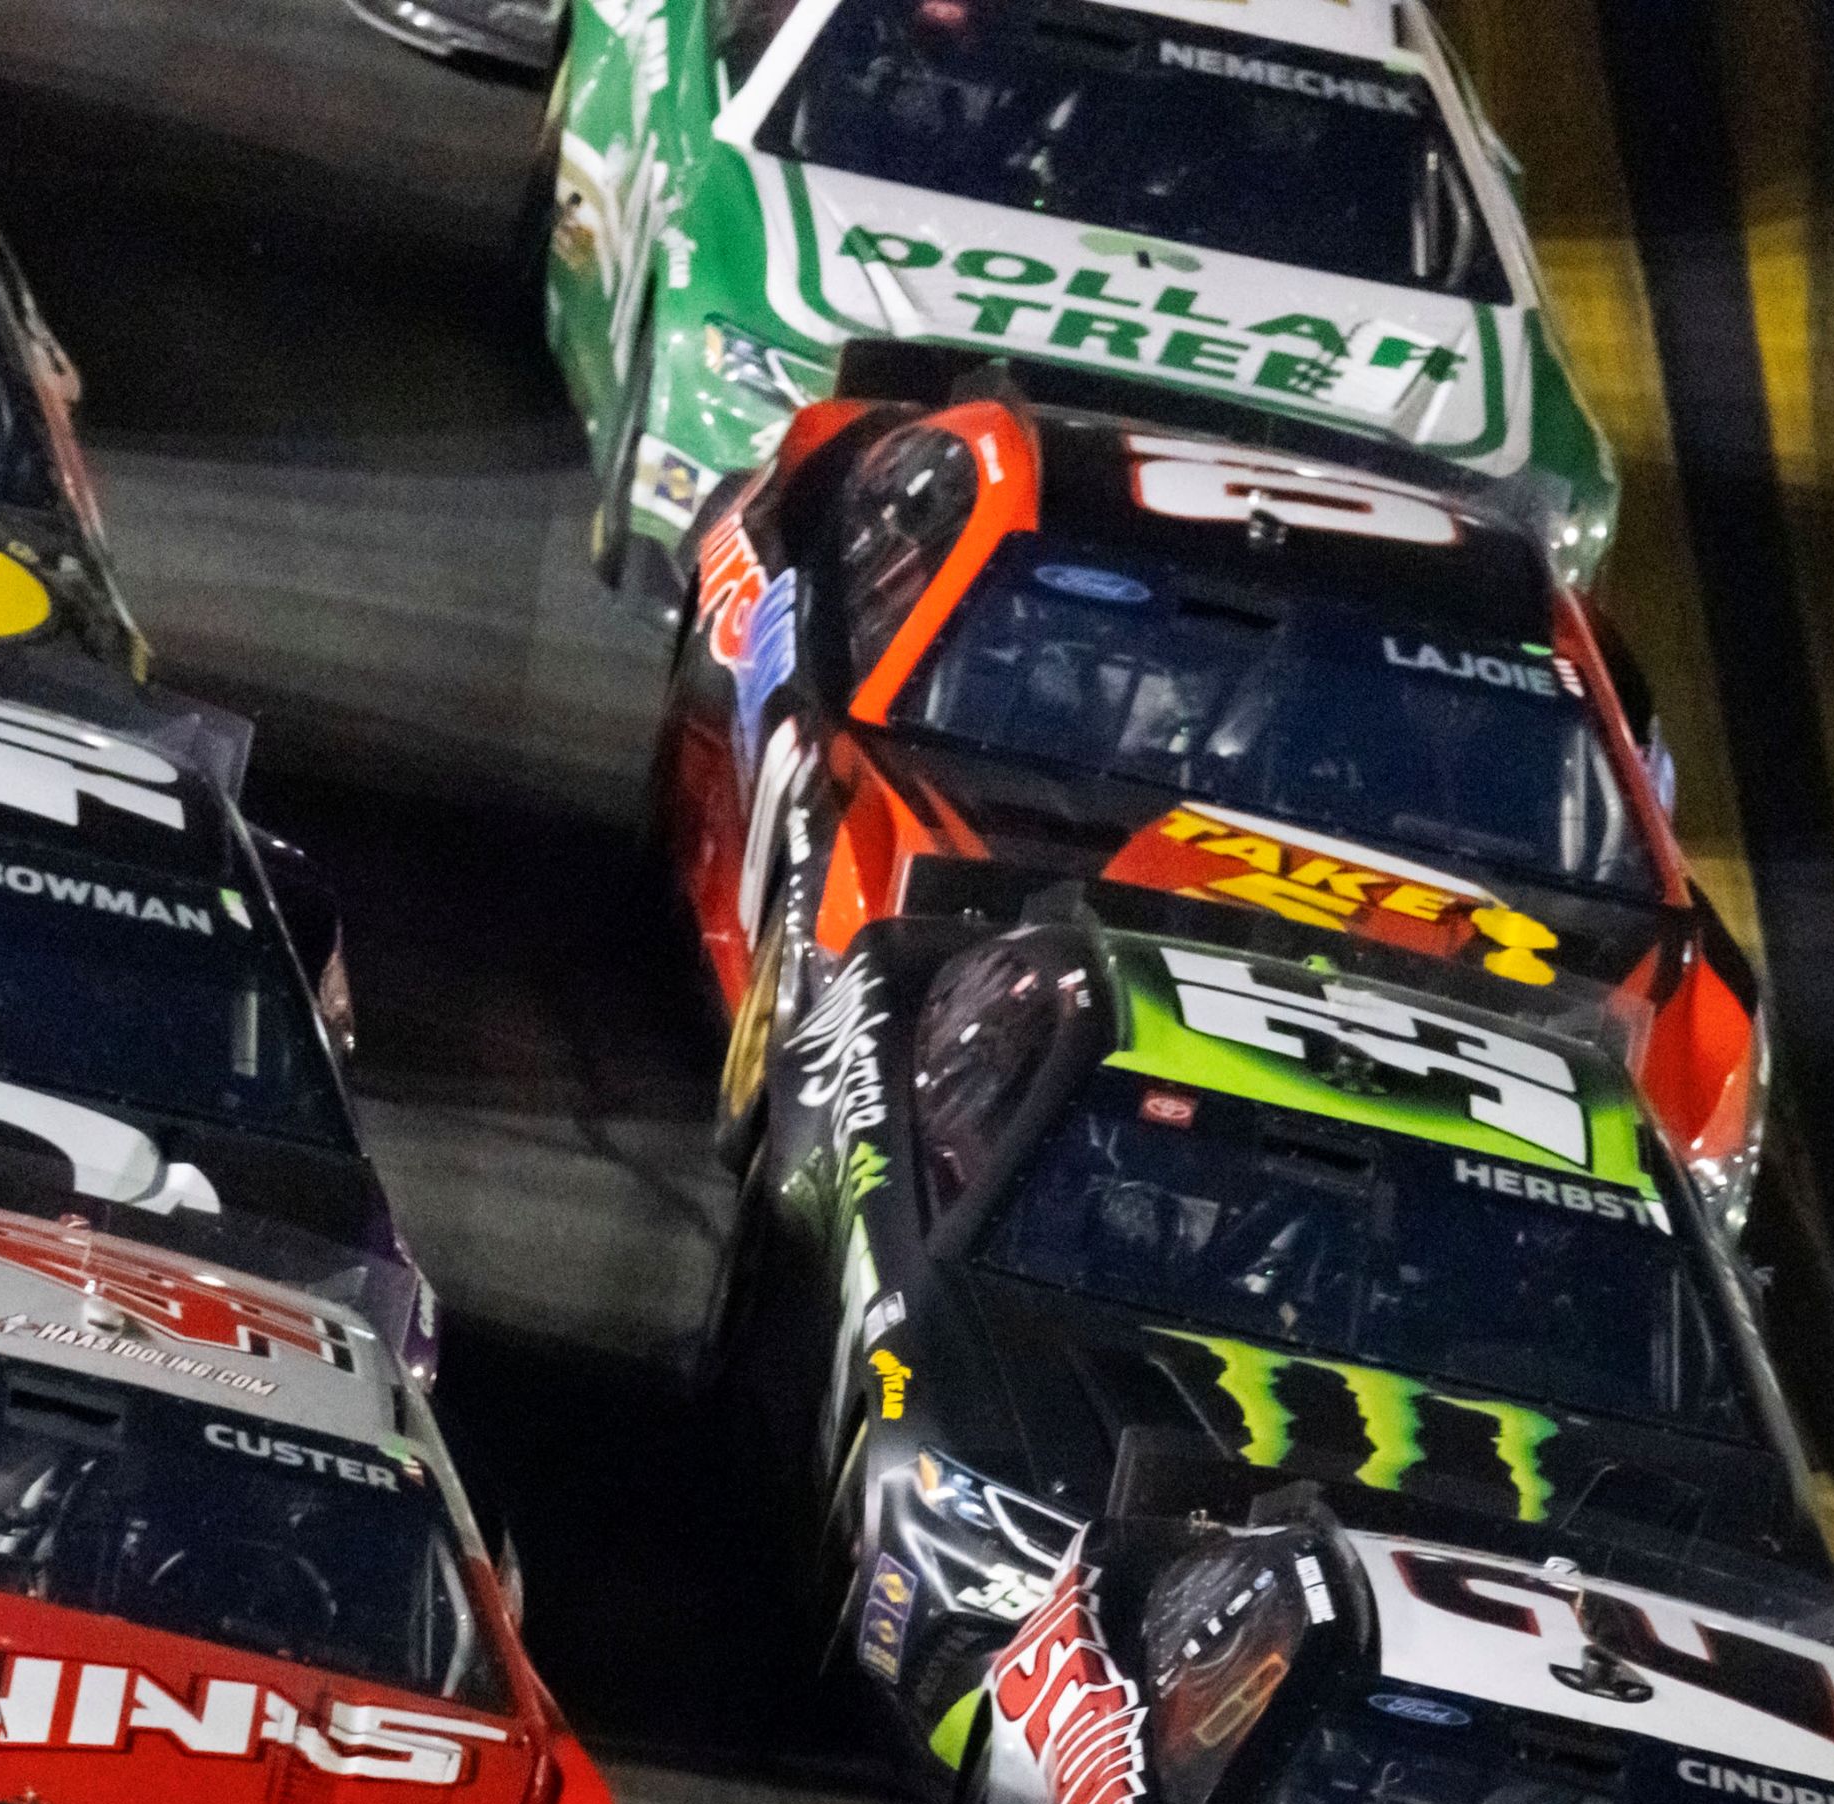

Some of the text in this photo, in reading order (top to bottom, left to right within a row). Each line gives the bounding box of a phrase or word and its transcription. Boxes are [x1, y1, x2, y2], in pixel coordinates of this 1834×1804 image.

[1159, 40, 1419, 116] NEMECHEK
[840, 225, 1467, 384] DOLLAR
[955, 292, 1344, 399] TREE
[1383, 637, 1556, 697] LAJOIE
[1159, 808, 1459, 922] TAKE
[1455, 1160, 1653, 1227] HERBST
[204, 1425, 401, 1494] CUSTER
